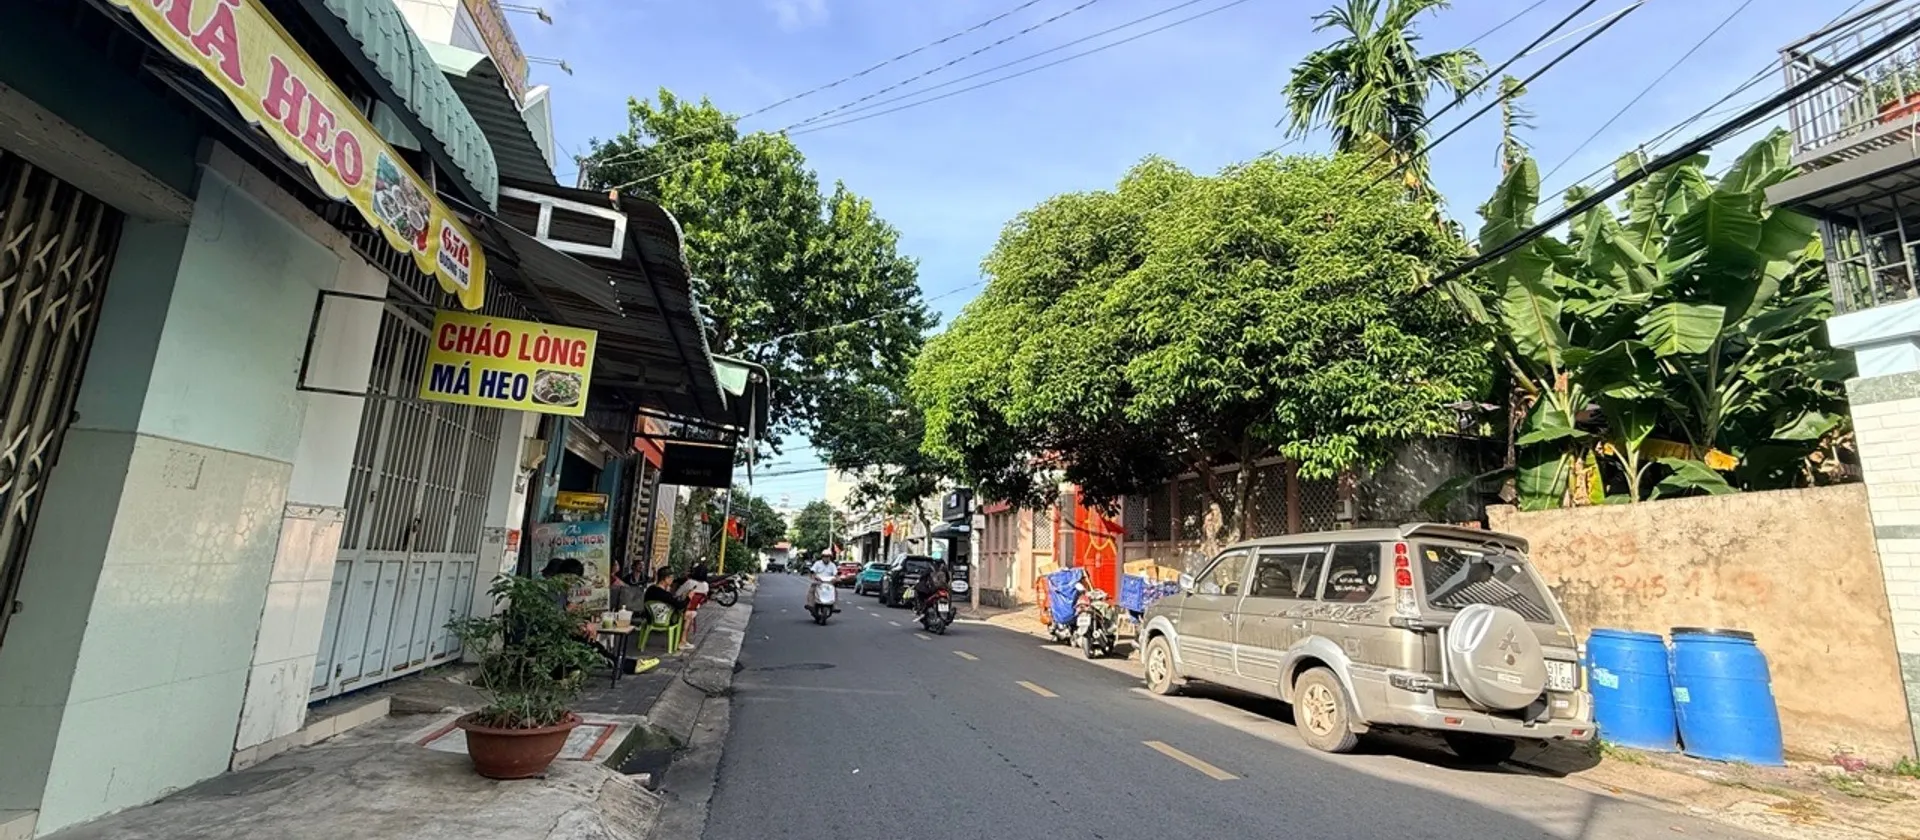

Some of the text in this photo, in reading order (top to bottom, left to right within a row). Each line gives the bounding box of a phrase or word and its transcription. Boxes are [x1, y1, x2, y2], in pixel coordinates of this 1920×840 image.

[262, 54, 363, 188] HEO
[442, 226, 469, 268] 65B
[438, 322, 587, 368] CHÁO LÒNG
[429, 360, 529, 401] MÁ HEO
